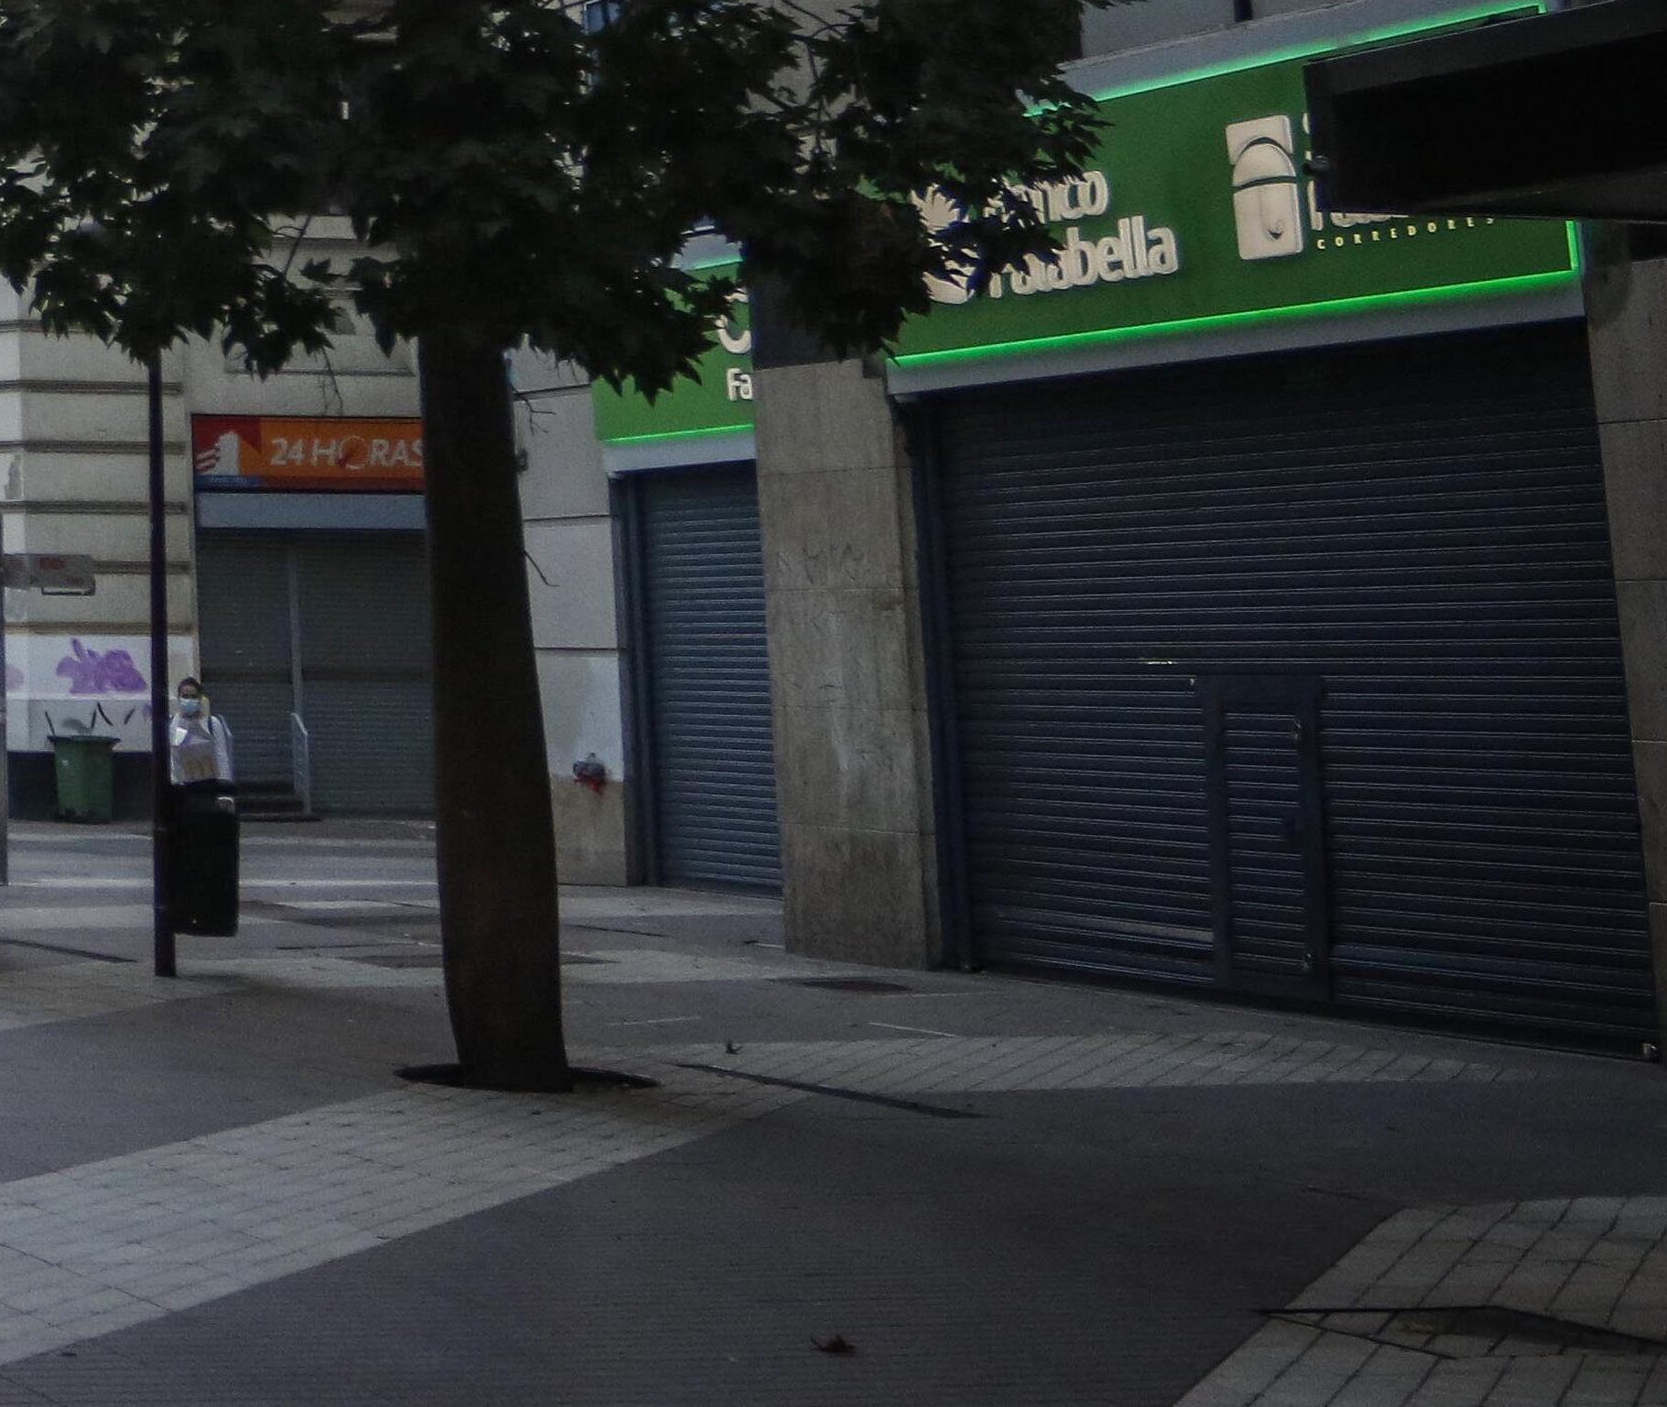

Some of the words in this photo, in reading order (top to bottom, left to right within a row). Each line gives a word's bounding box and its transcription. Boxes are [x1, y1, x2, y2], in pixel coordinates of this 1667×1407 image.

[989, 215, 1180, 299] alabella
[270, 437, 306, 468] 24
[309, 434, 424, 470] HORAS
